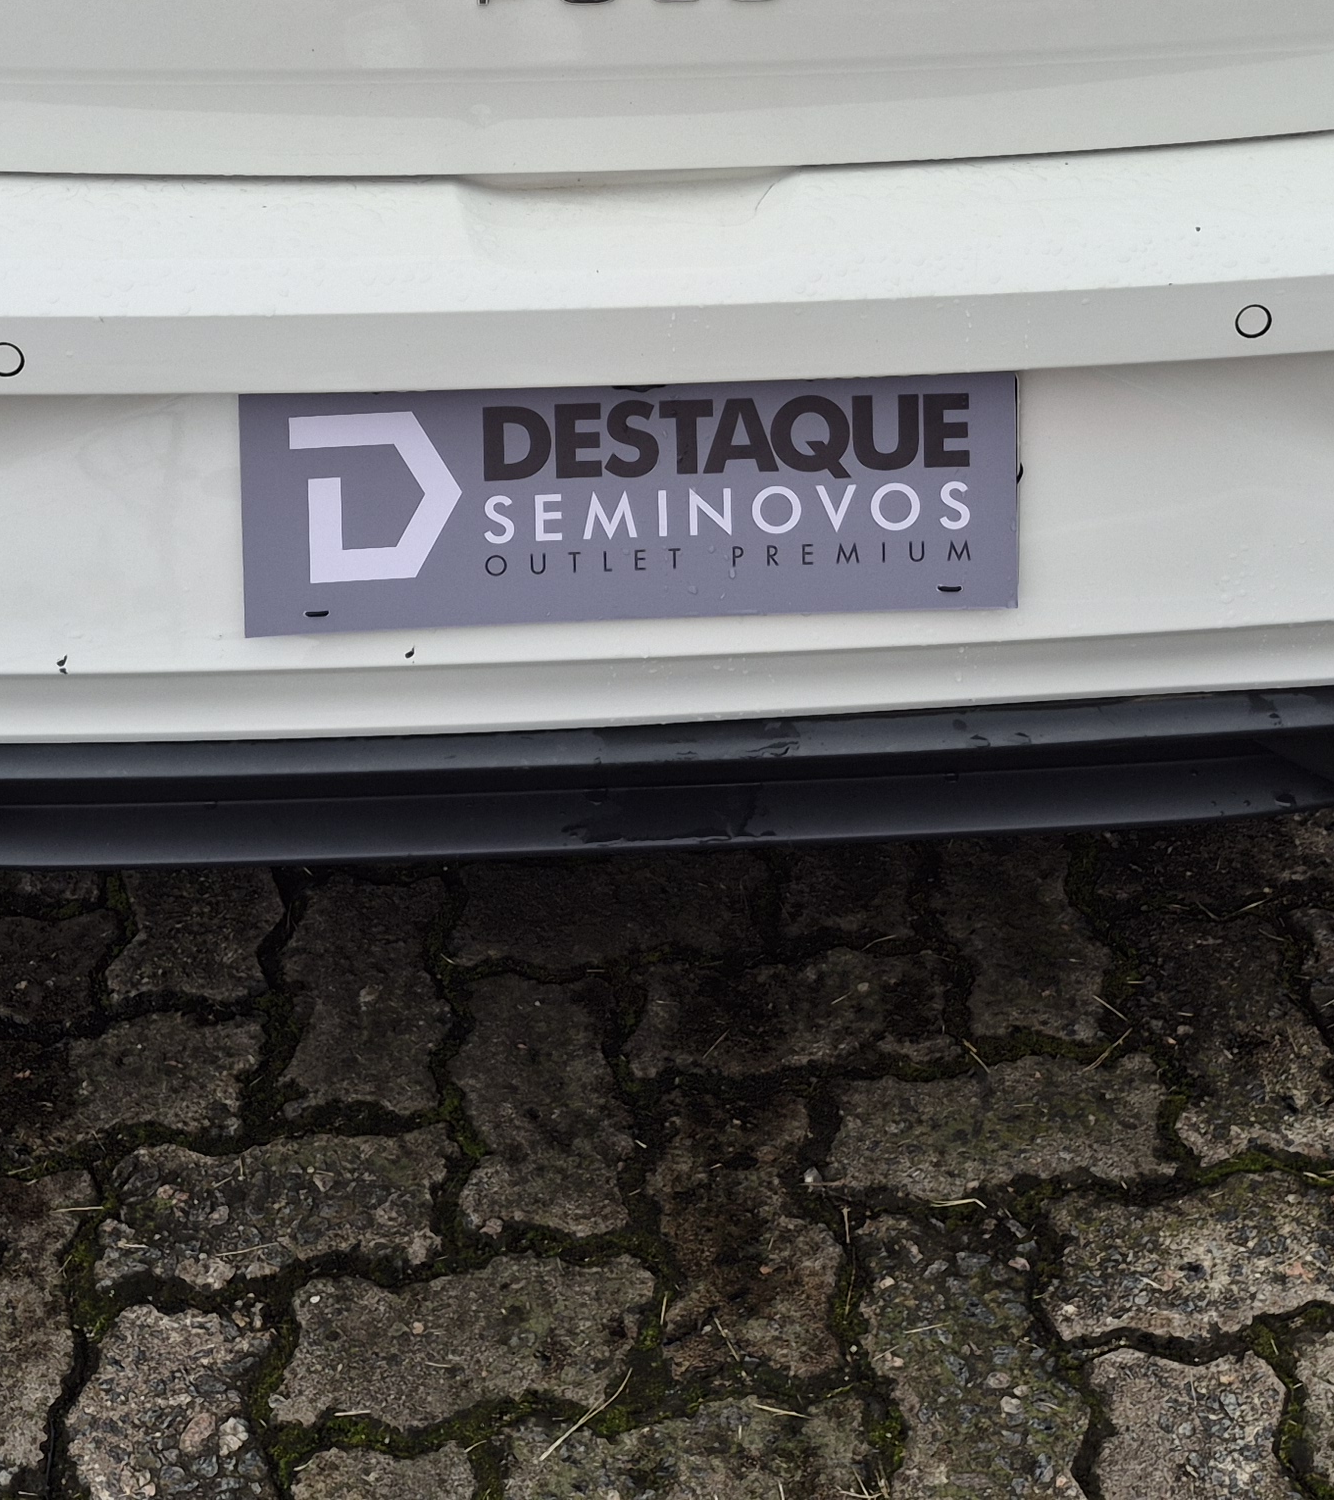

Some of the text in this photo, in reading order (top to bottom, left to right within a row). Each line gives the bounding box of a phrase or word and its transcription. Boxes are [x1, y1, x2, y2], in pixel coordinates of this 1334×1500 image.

[482, 392, 971, 483] DESTAQUE
[483, 480, 972, 545] SEMINOVOS
[484, 540, 973, 577] OUTLET PREMIUM
